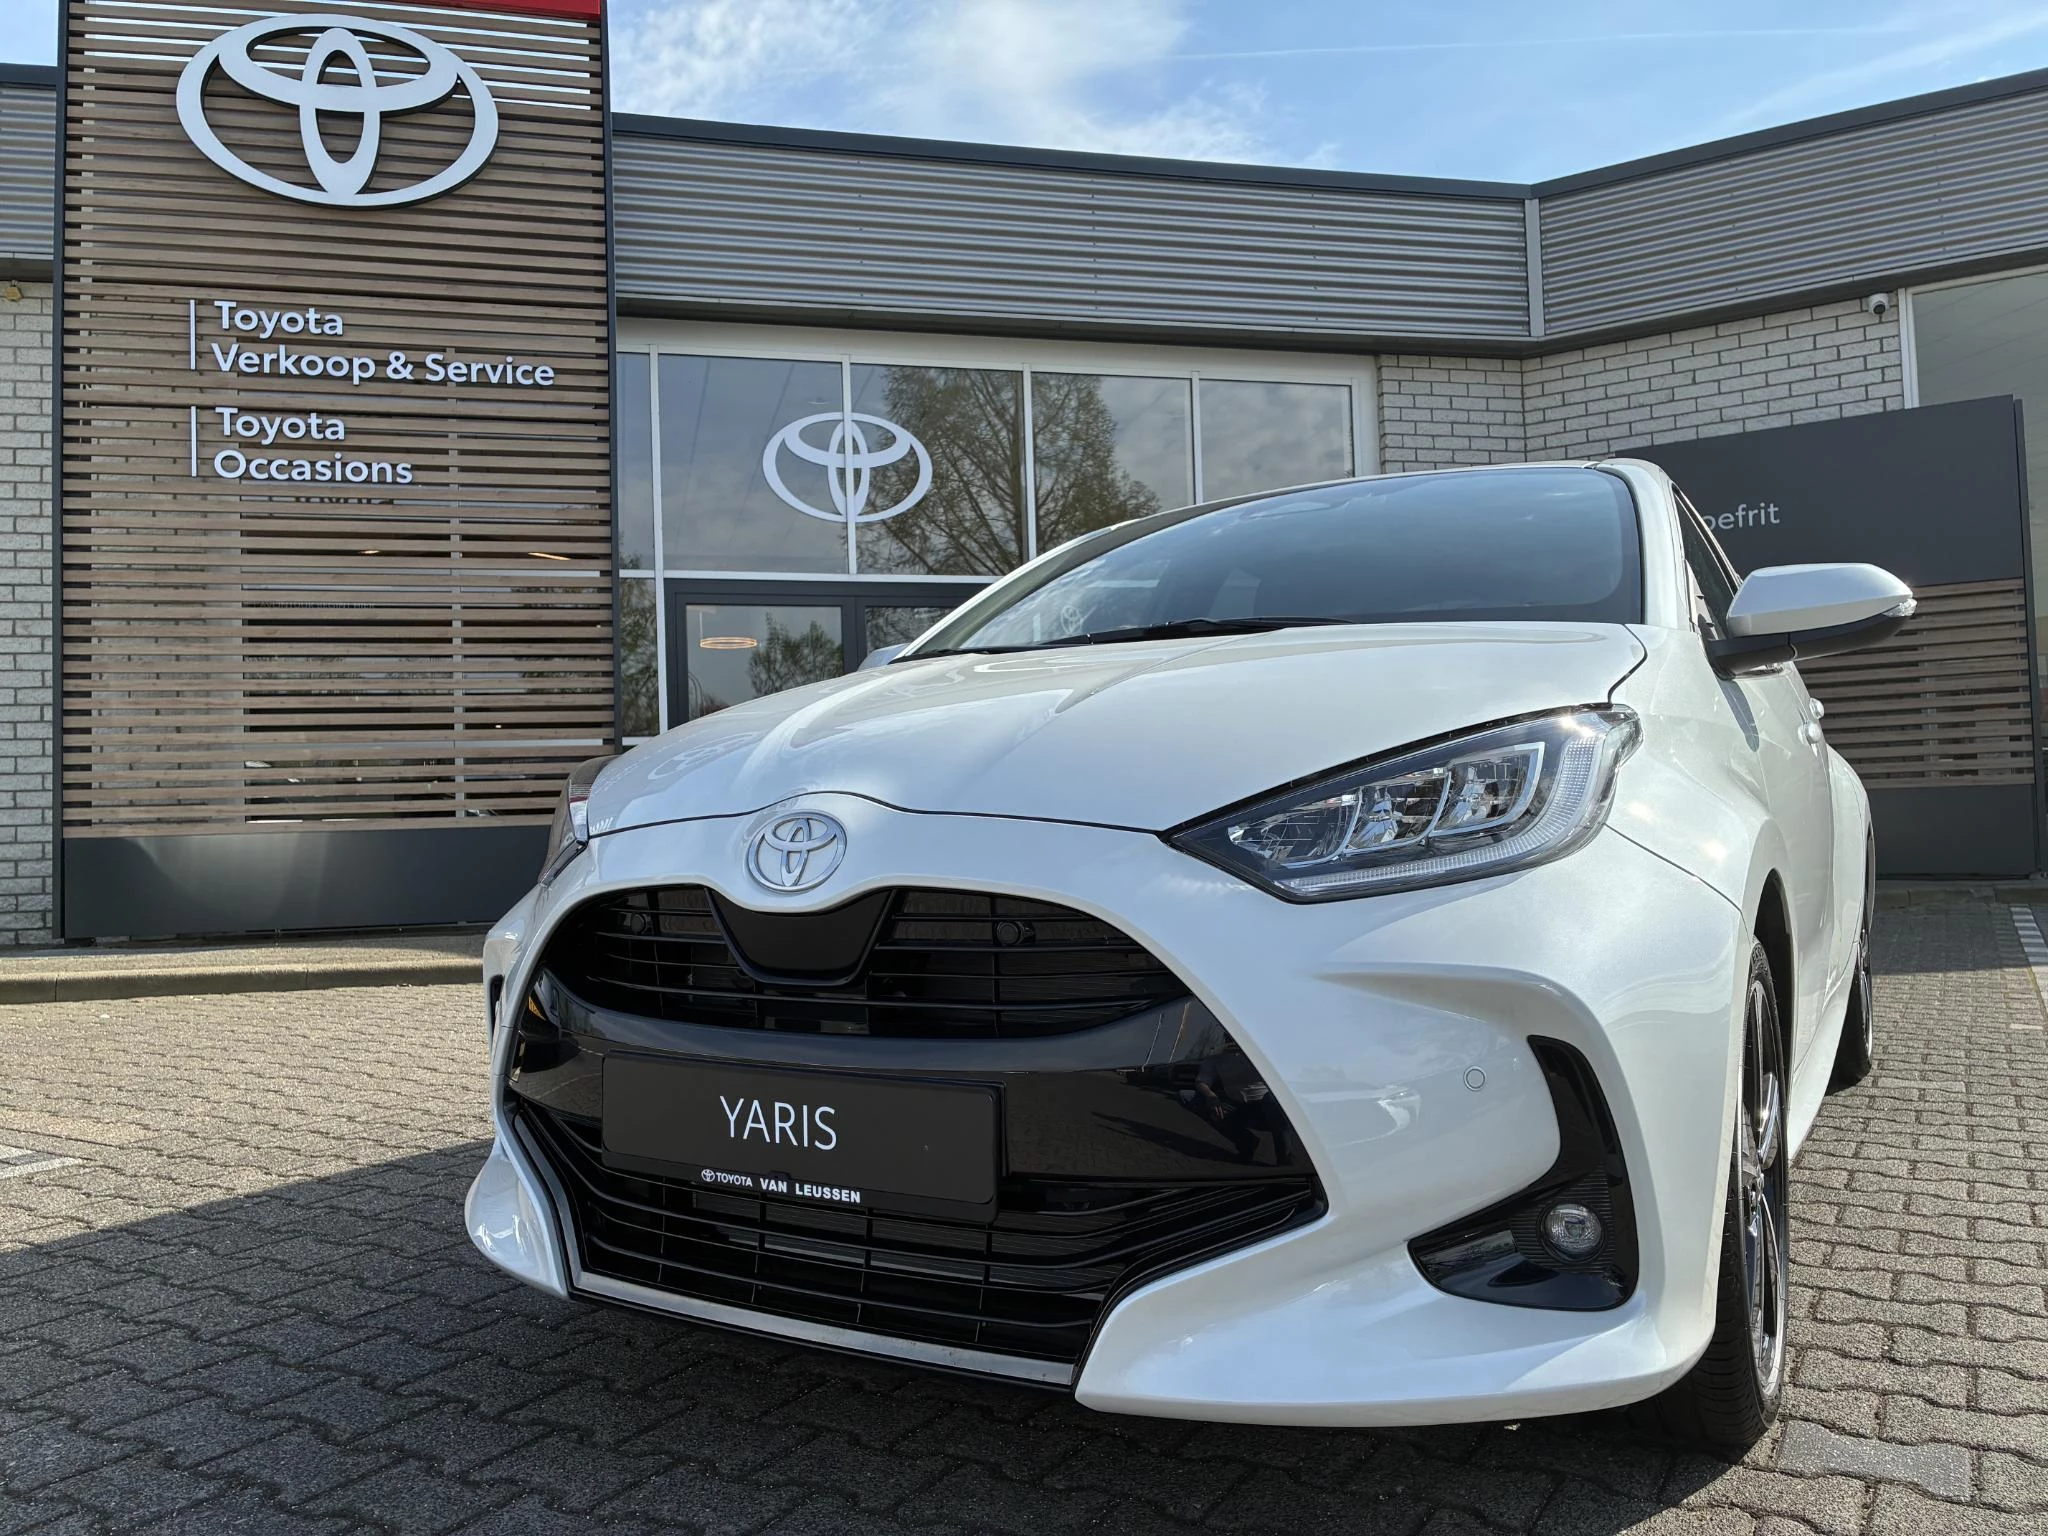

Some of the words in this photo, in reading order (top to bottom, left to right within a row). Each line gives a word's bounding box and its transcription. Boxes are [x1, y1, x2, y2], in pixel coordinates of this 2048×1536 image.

[214, 300, 344, 339] Toyota
[211, 342, 376, 384] Verkoop
[386, 351, 414, 380] &
[425, 353, 556, 386] Service
[215, 407, 346, 444] Toyota
[214, 449, 413, 484] Occasions
[1702, 502, 1780, 531] oefrit
[719, 1095, 838, 1151] YARIS
[715, 1172, 753, 1188] TOYOTA
[759, 1177, 788, 1194] VAN
[795, 1182, 861, 1204] LEUSSEN
